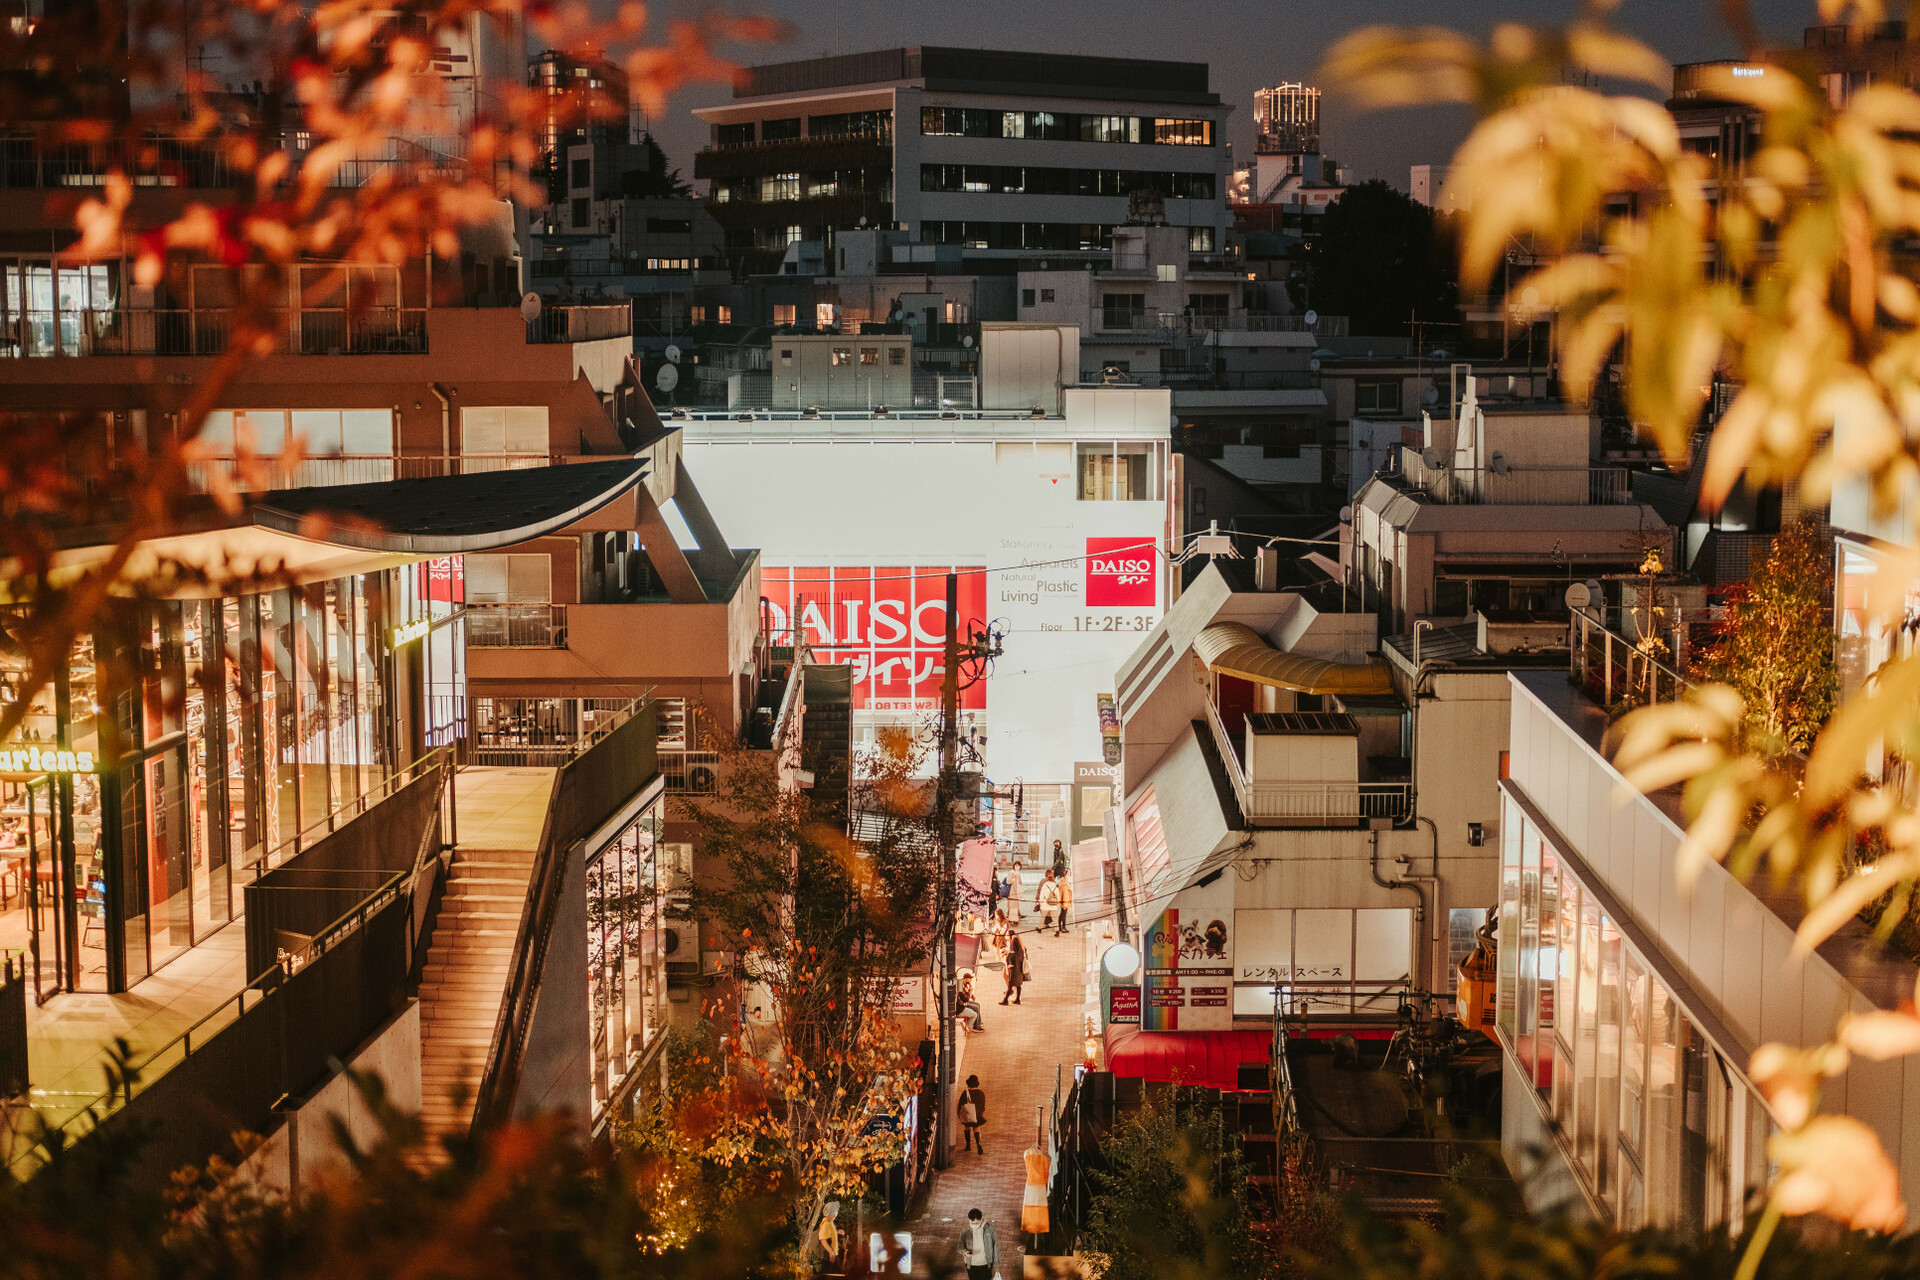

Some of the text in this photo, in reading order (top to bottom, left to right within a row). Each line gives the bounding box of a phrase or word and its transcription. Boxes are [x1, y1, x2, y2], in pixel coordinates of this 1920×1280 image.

[1091, 559, 1150, 572] DAISO
[1001, 573, 1036, 581] Natural
[1117, 575, 1148, 585] ダイソー
[1036, 580, 1078, 592] Plastic
[1001, 590, 1038, 605] Living
[760, 599, 960, 644] DAISO
[1079, 767, 1118, 777] DAISO
